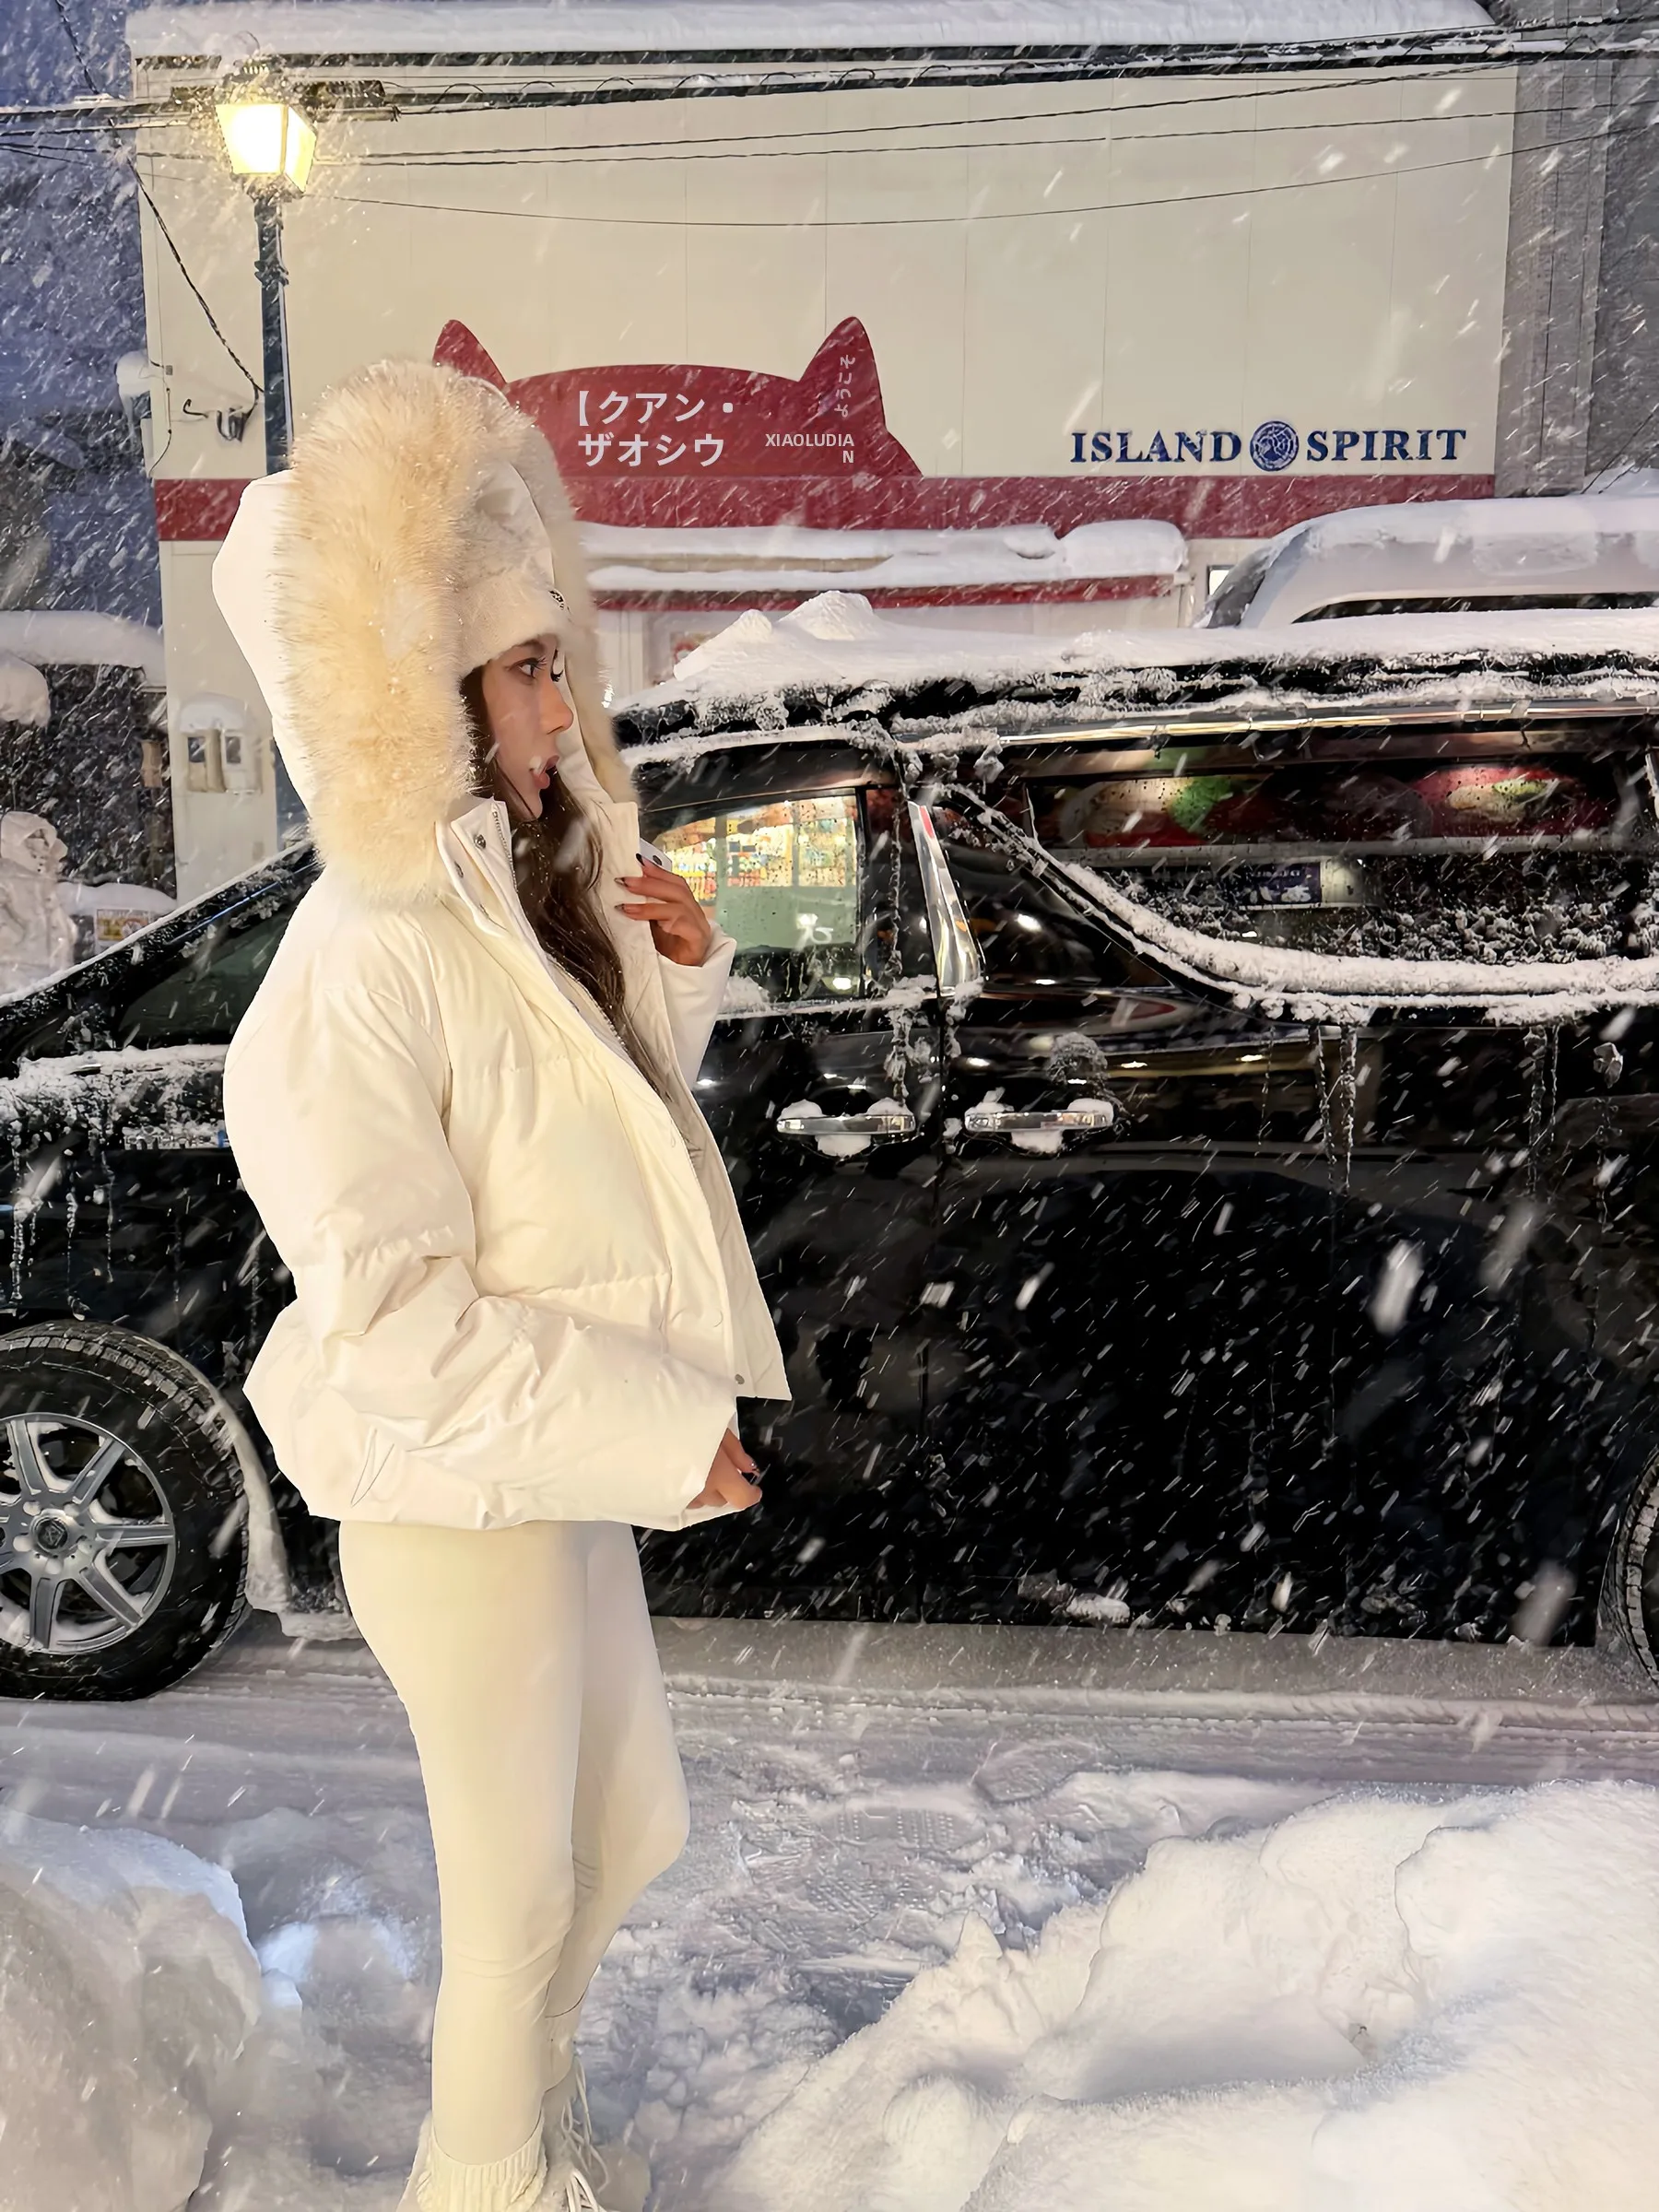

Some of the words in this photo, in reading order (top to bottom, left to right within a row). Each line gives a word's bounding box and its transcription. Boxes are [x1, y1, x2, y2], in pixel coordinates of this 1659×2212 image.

[577, 431, 724, 467] ザオシウ
[765, 433, 855, 447] XIAOLUDIA
[1070, 430, 1242, 463] ISLAND
[1306, 429, 1467, 462] SPIRIT
[841, 450, 854, 464] N
